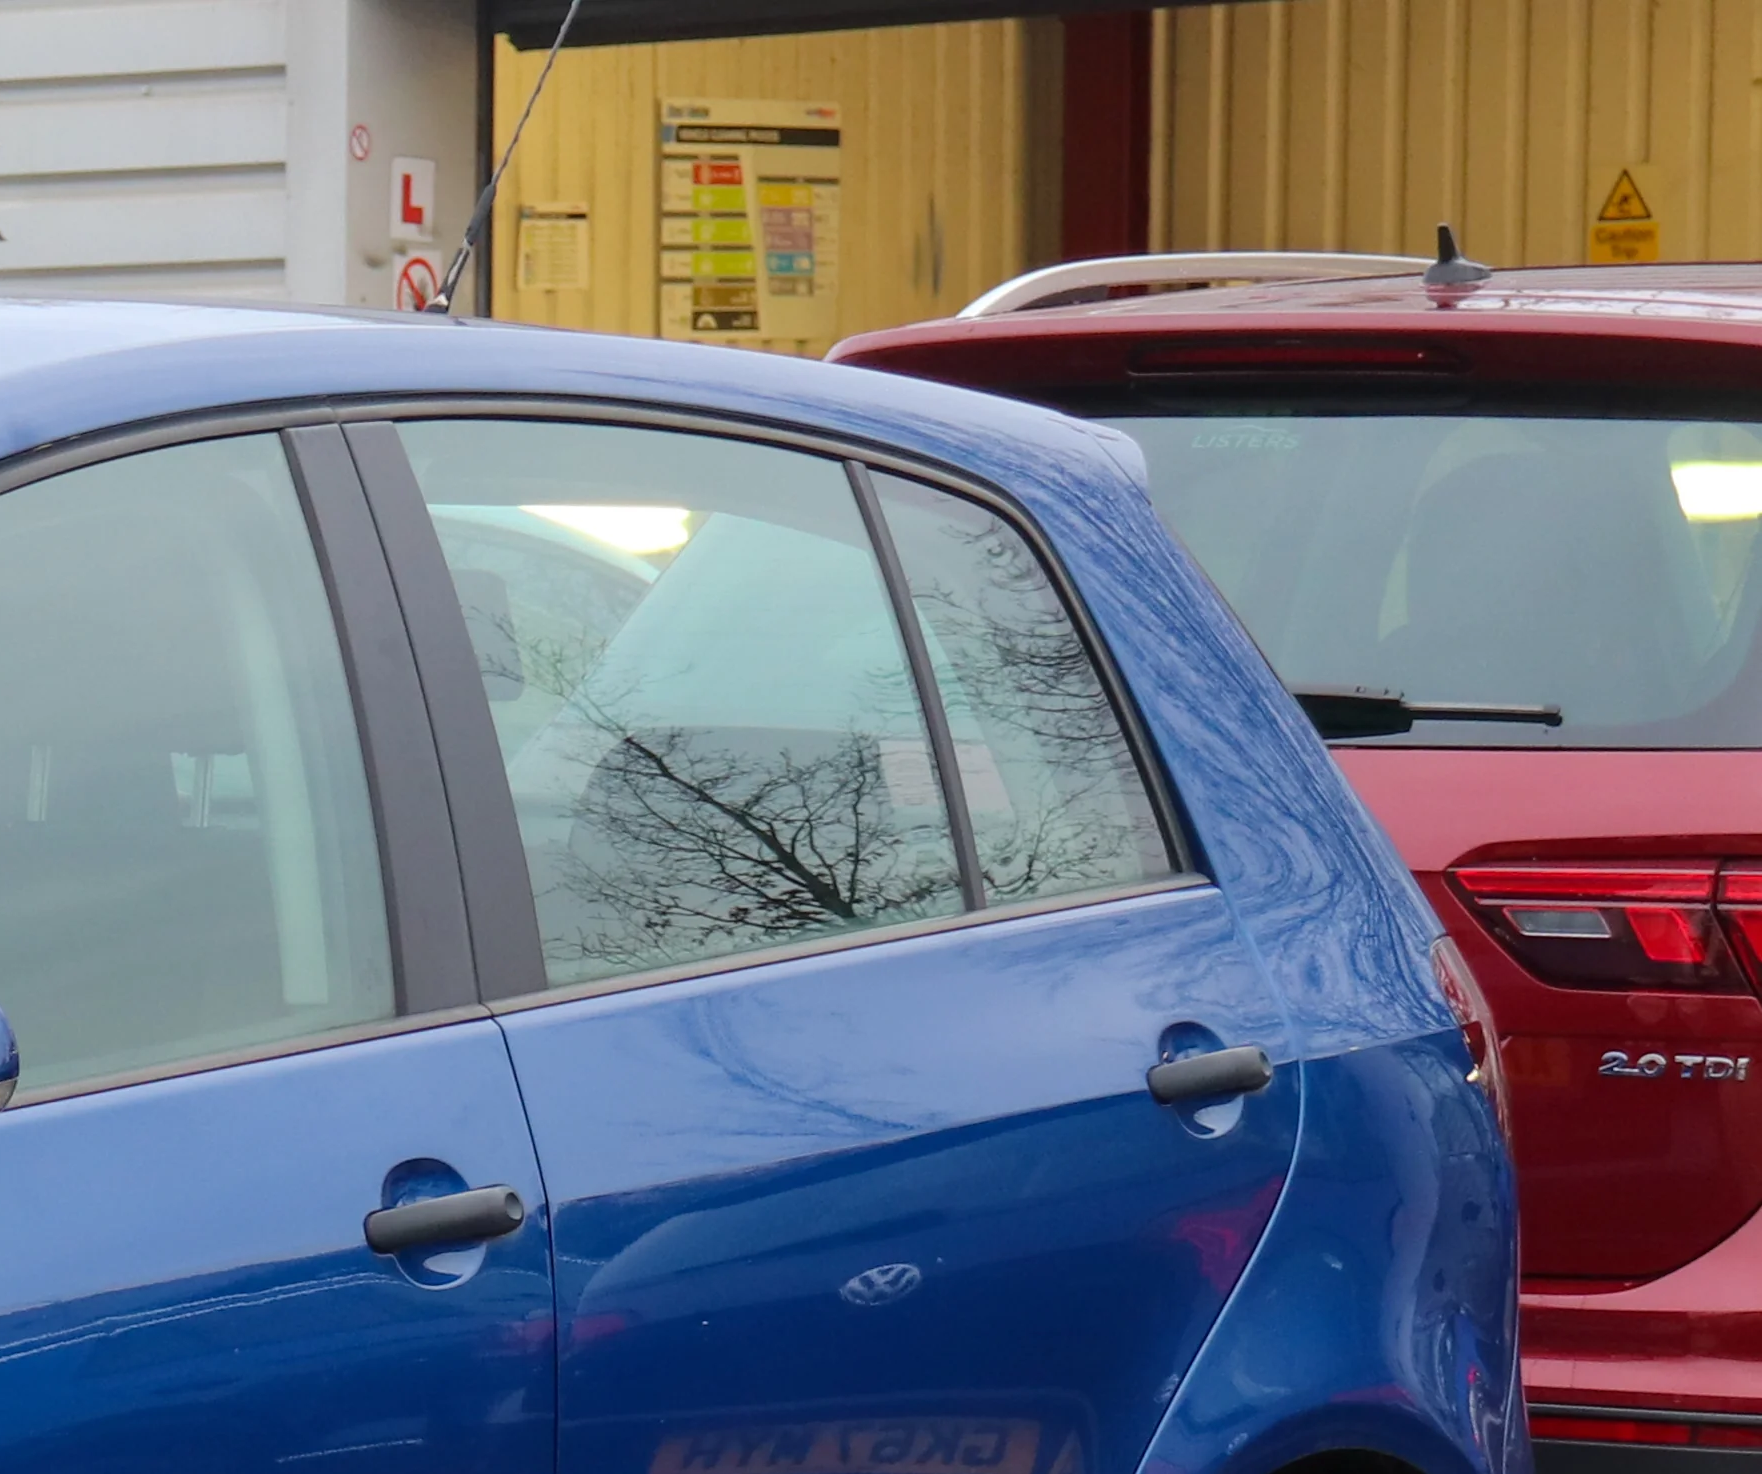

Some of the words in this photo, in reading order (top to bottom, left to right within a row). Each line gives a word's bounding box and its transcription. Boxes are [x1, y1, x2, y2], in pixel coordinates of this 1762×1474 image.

[402, 173, 424, 225] L
[1191, 434, 1299, 449] LISTERS
[1674, 1055, 1751, 1081] TDI
